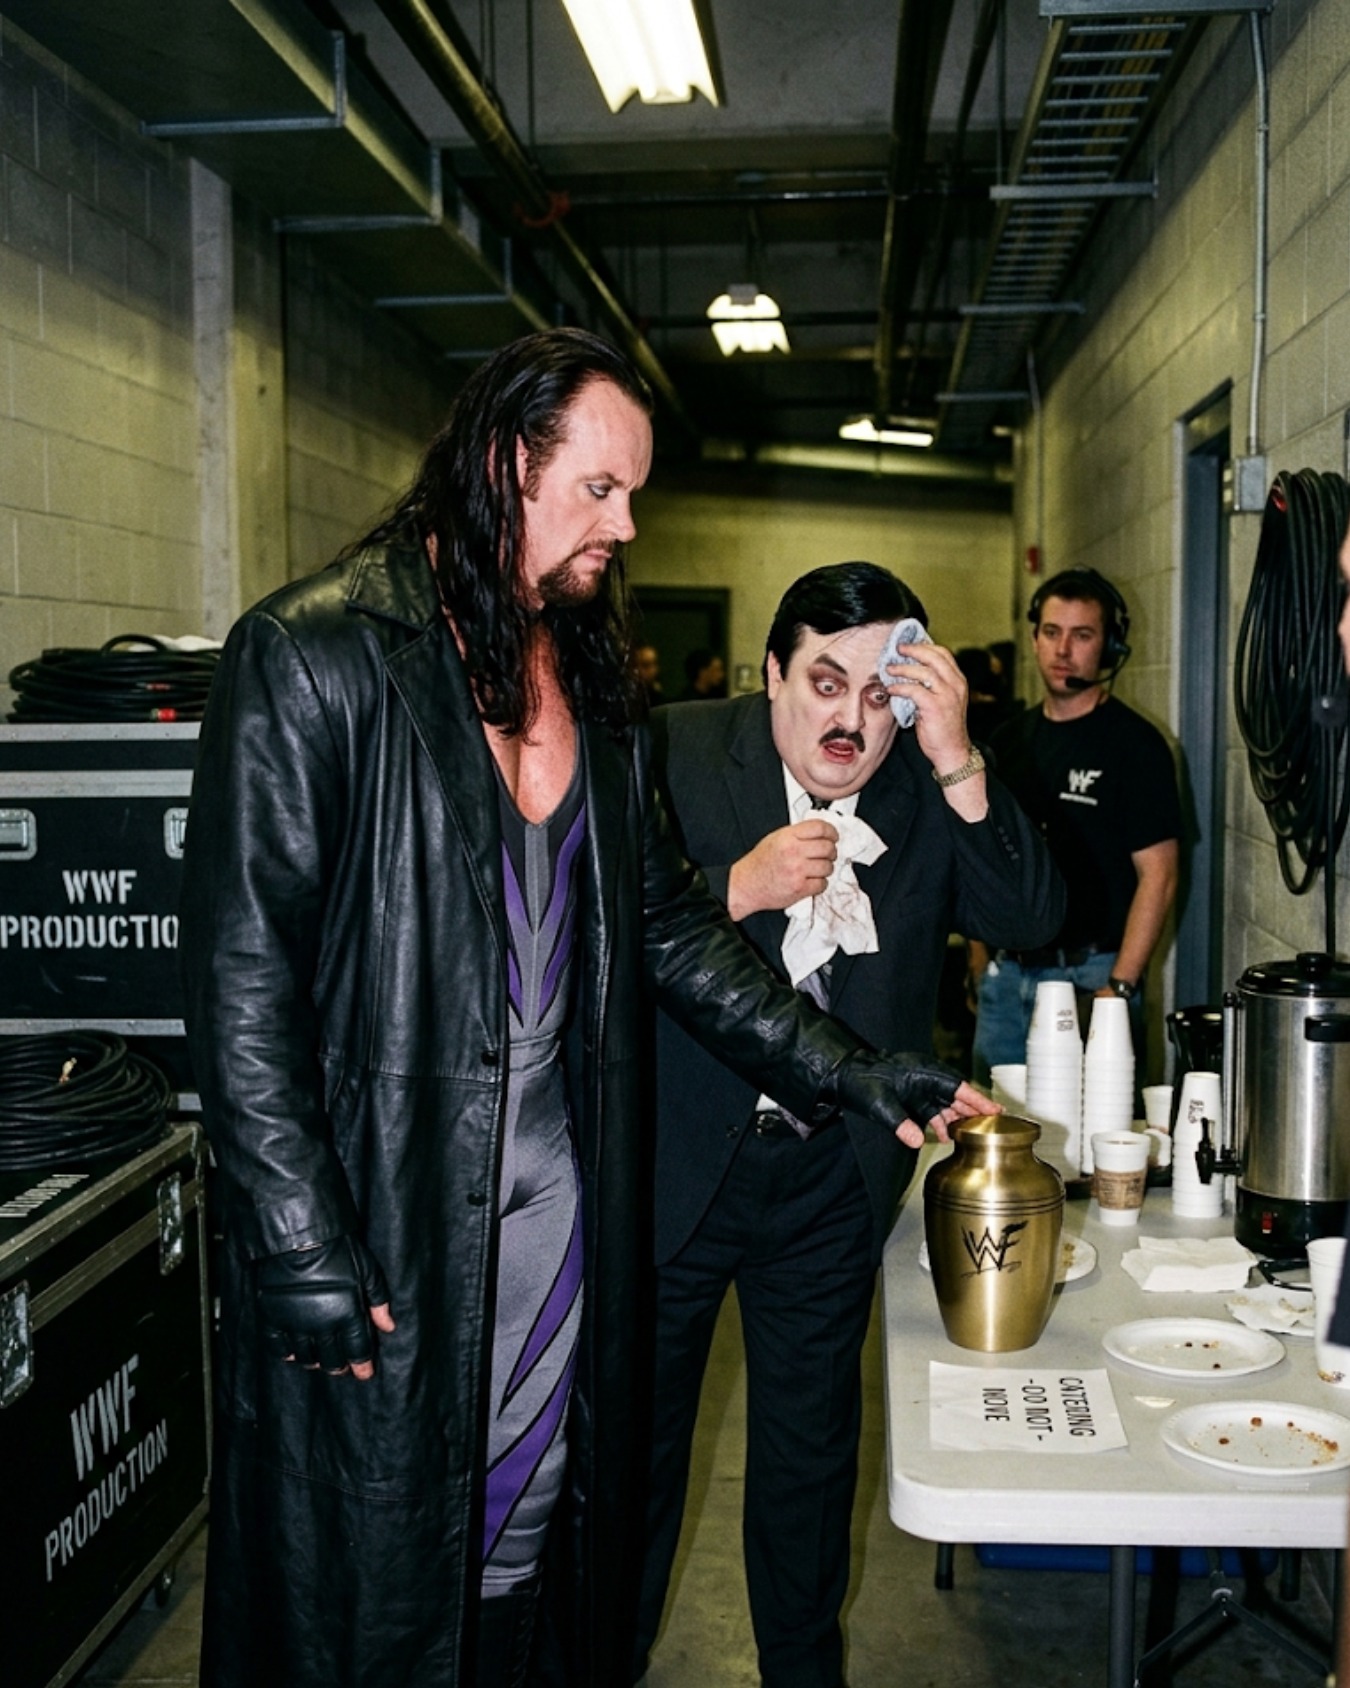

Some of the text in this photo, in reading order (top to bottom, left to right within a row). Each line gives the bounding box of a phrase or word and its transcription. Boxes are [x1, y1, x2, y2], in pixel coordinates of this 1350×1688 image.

[62, 870, 137, 904] WWF
[0, 915, 179, 948] PRODUCTIO
[70, 1354, 139, 1481] WWF
[1059, 1377, 1096, 1437] CATERING
[45, 1419, 168, 1582] PRODUCTION
